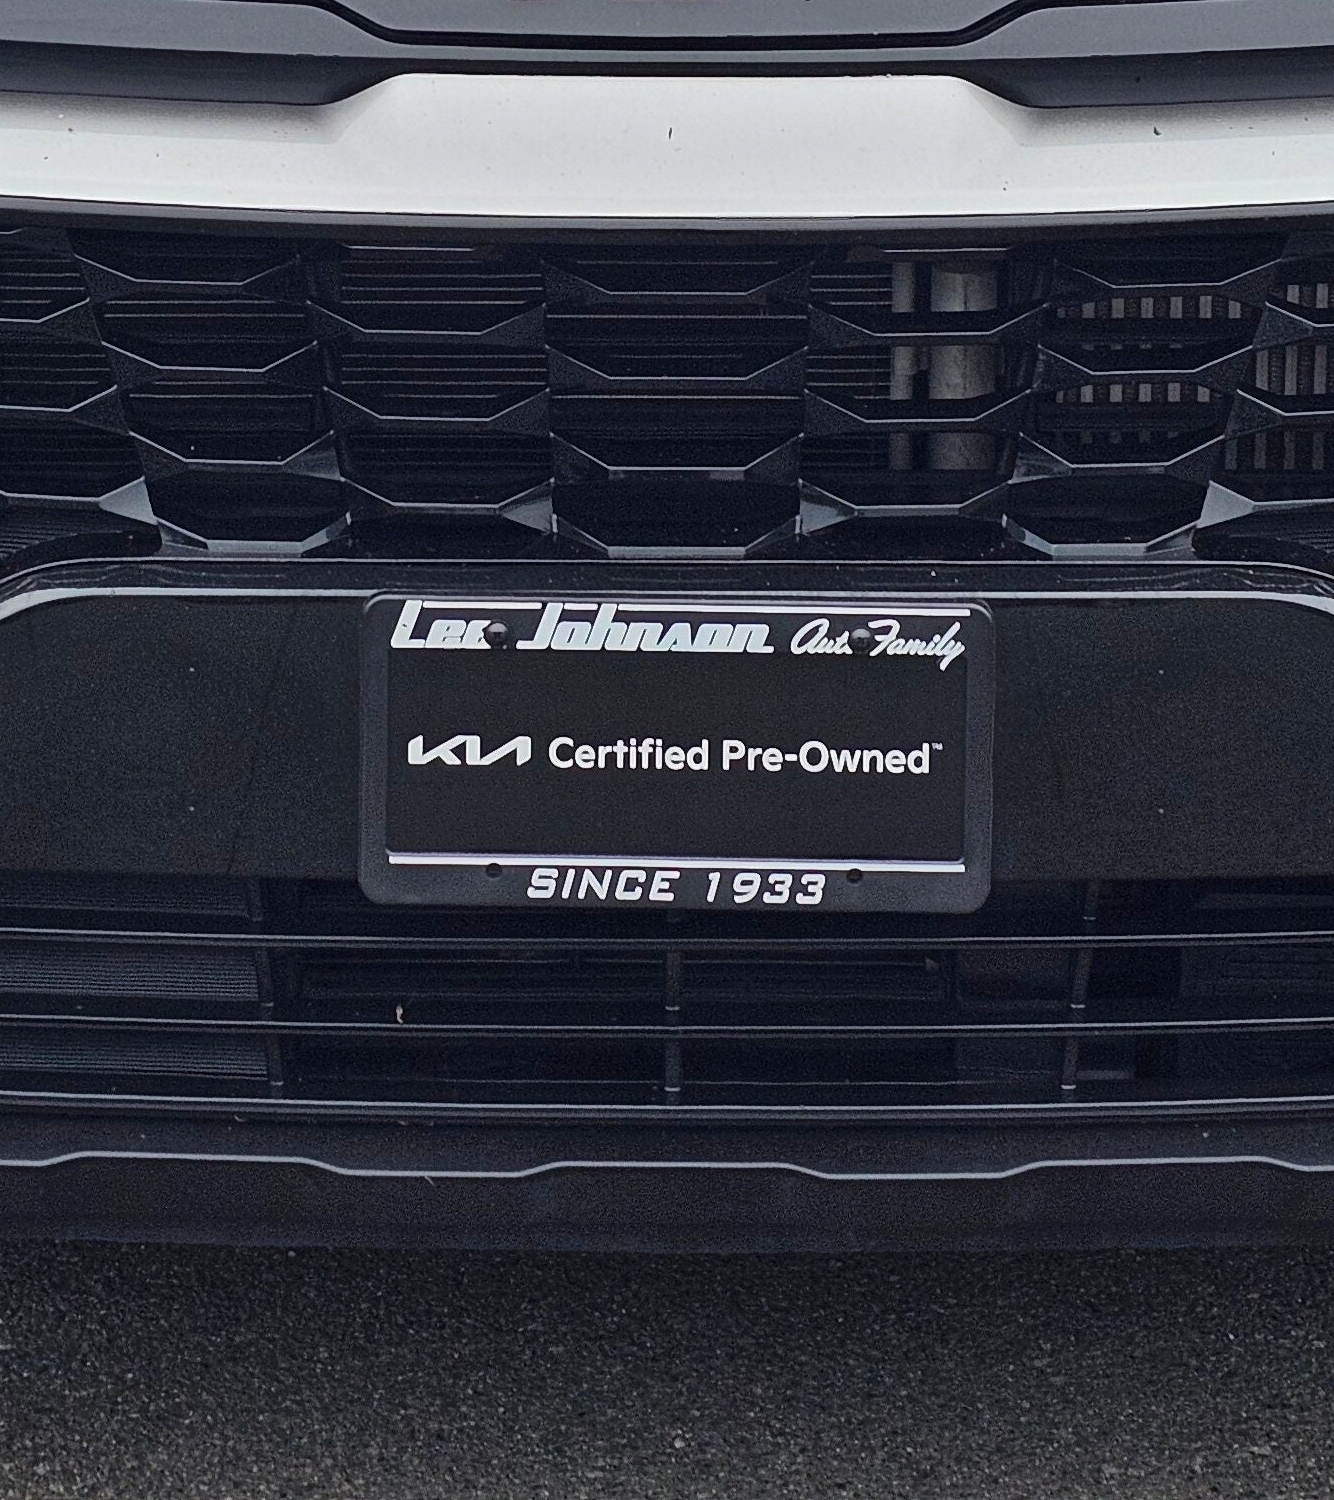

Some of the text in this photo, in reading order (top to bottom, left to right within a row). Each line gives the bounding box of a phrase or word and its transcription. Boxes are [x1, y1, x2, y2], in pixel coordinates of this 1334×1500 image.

[515, 602, 775, 655] Johnson
[789, 617, 854, 656] Aut
[867, 618, 966, 672] Family
[406, 734, 533, 767] KIA
[548, 736, 710, 772] Certified
[525, 868, 828, 906] SINCE 1933
